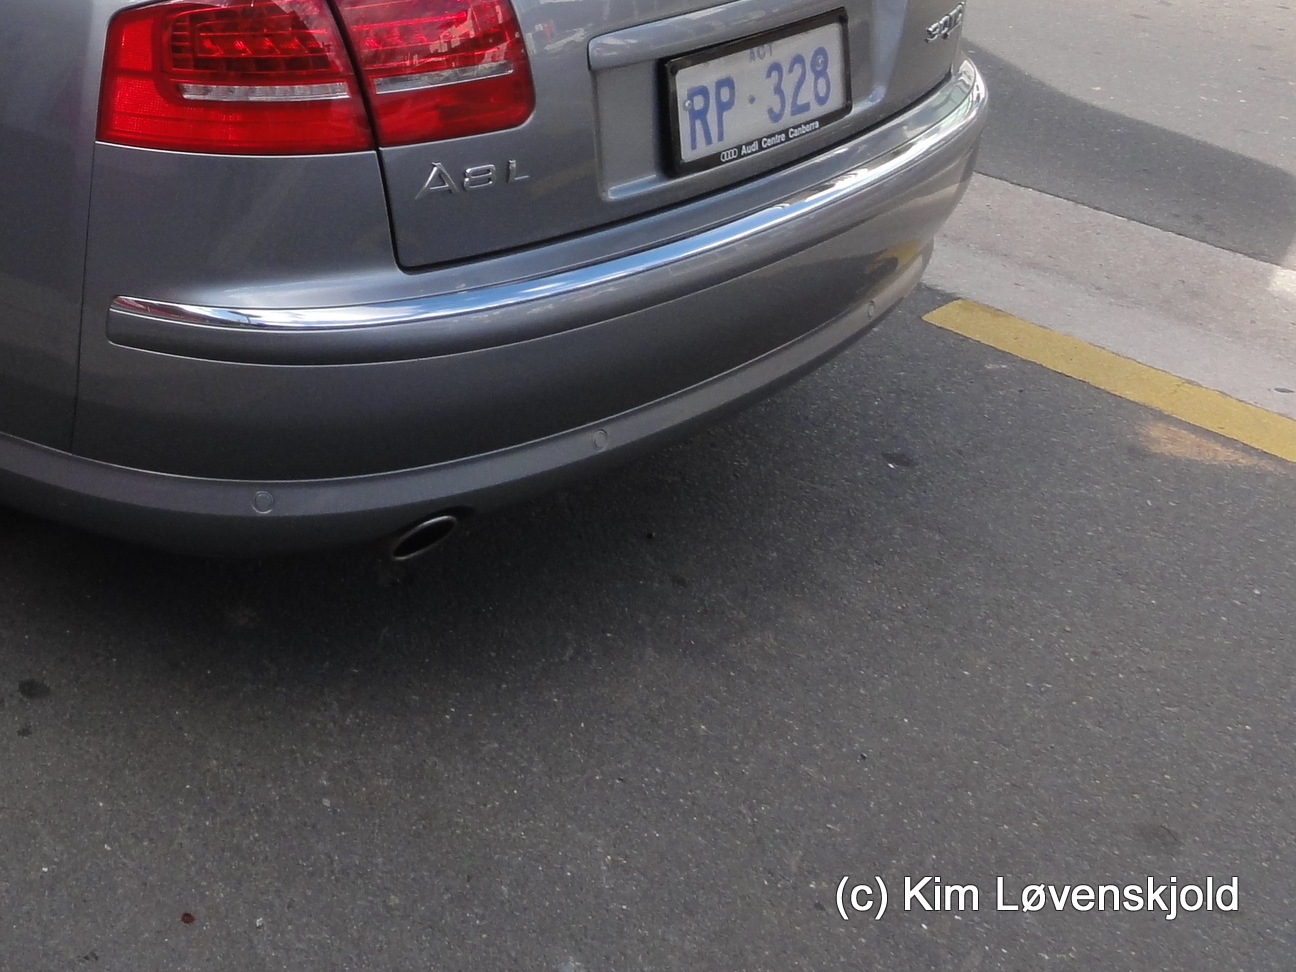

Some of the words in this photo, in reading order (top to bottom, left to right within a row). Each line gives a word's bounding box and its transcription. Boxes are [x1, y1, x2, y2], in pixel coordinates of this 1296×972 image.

[749, 43, 773, 63] ACT
[740, 140, 759, 156] Audi
[761, 133, 786, 148] Centre
[788, 120, 820, 139] Canberra
